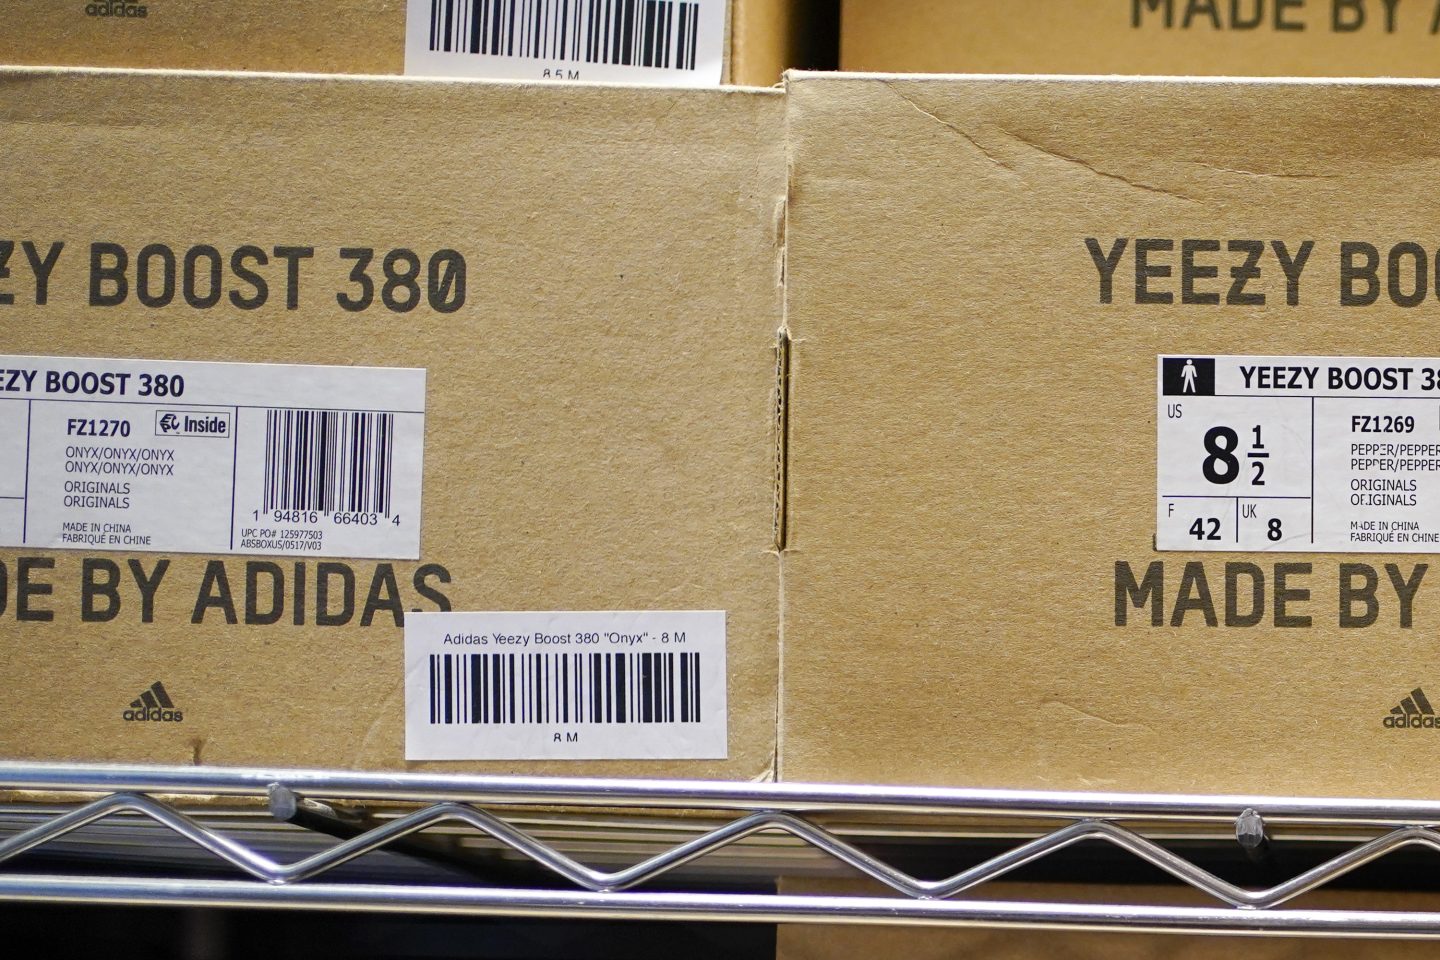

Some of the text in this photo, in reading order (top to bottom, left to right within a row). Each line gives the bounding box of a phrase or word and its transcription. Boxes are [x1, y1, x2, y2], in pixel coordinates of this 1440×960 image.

[85, 1, 148, 18] adidas
[1130, 0, 1305, 32] MADE
[1330, 0, 1405, 35] BY
[89, 241, 313, 311] BOOST
[337, 247, 467, 313] 380
[1084, 237, 1314, 306] YEEZY
[46, 371, 185, 397] BOOST 380
[1240, 366, 1319, 389] YEEZY
[1328, 367, 1413, 390] BOOST
[1168, 404, 1182, 418] US
[67, 419, 131, 437] FZ1270
[184, 416, 226, 434] Inside
[1351, 416, 1415, 433] FZ1269
[65, 446, 174, 461] ONYX/ONYX/ONYX
[1202, 426, 1239, 484] 8
[65, 461, 174, 476] ONYX/ONYX/ONYX
[64, 481, 130, 494] ORIGINALS
[1350, 479, 1417, 491] ORIGINALS
[64, 495, 130, 508] ORIGINALS
[274, 511, 318, 523] 94816
[334, 512, 378, 525] 66403
[1168, 504, 1174, 517] F
[1243, 505, 1256, 518] UK
[63, 523, 131, 533] MADE IN CHINA
[241, 528, 257, 538] UPC
[260, 529, 277, 538] PO#
[1189, 518, 1221, 540] 42
[1267, 519, 1282, 541] 8
[1350, 522, 1419, 531] MADE IN CHINA
[108, 535, 120, 544] EN
[123, 535, 151, 545] CHINE
[1398, 533, 1410, 542] EN
[1412, 533, 1439, 542] CHINE
[81, 558, 183, 623] BY
[191, 561, 453, 628] ADIDAS
[1115, 561, 1311, 628] MADE
[1339, 563, 1437, 629] BY
[444, 633, 488, 645] Adidas
[492, 633, 530, 645] Yeezy
[534, 633, 571, 644] Boost
[575, 633, 599, 644] 380
[662, 633, 669, 643] 8
[674, 632, 686, 643] M
[122, 707, 183, 723] adidas
